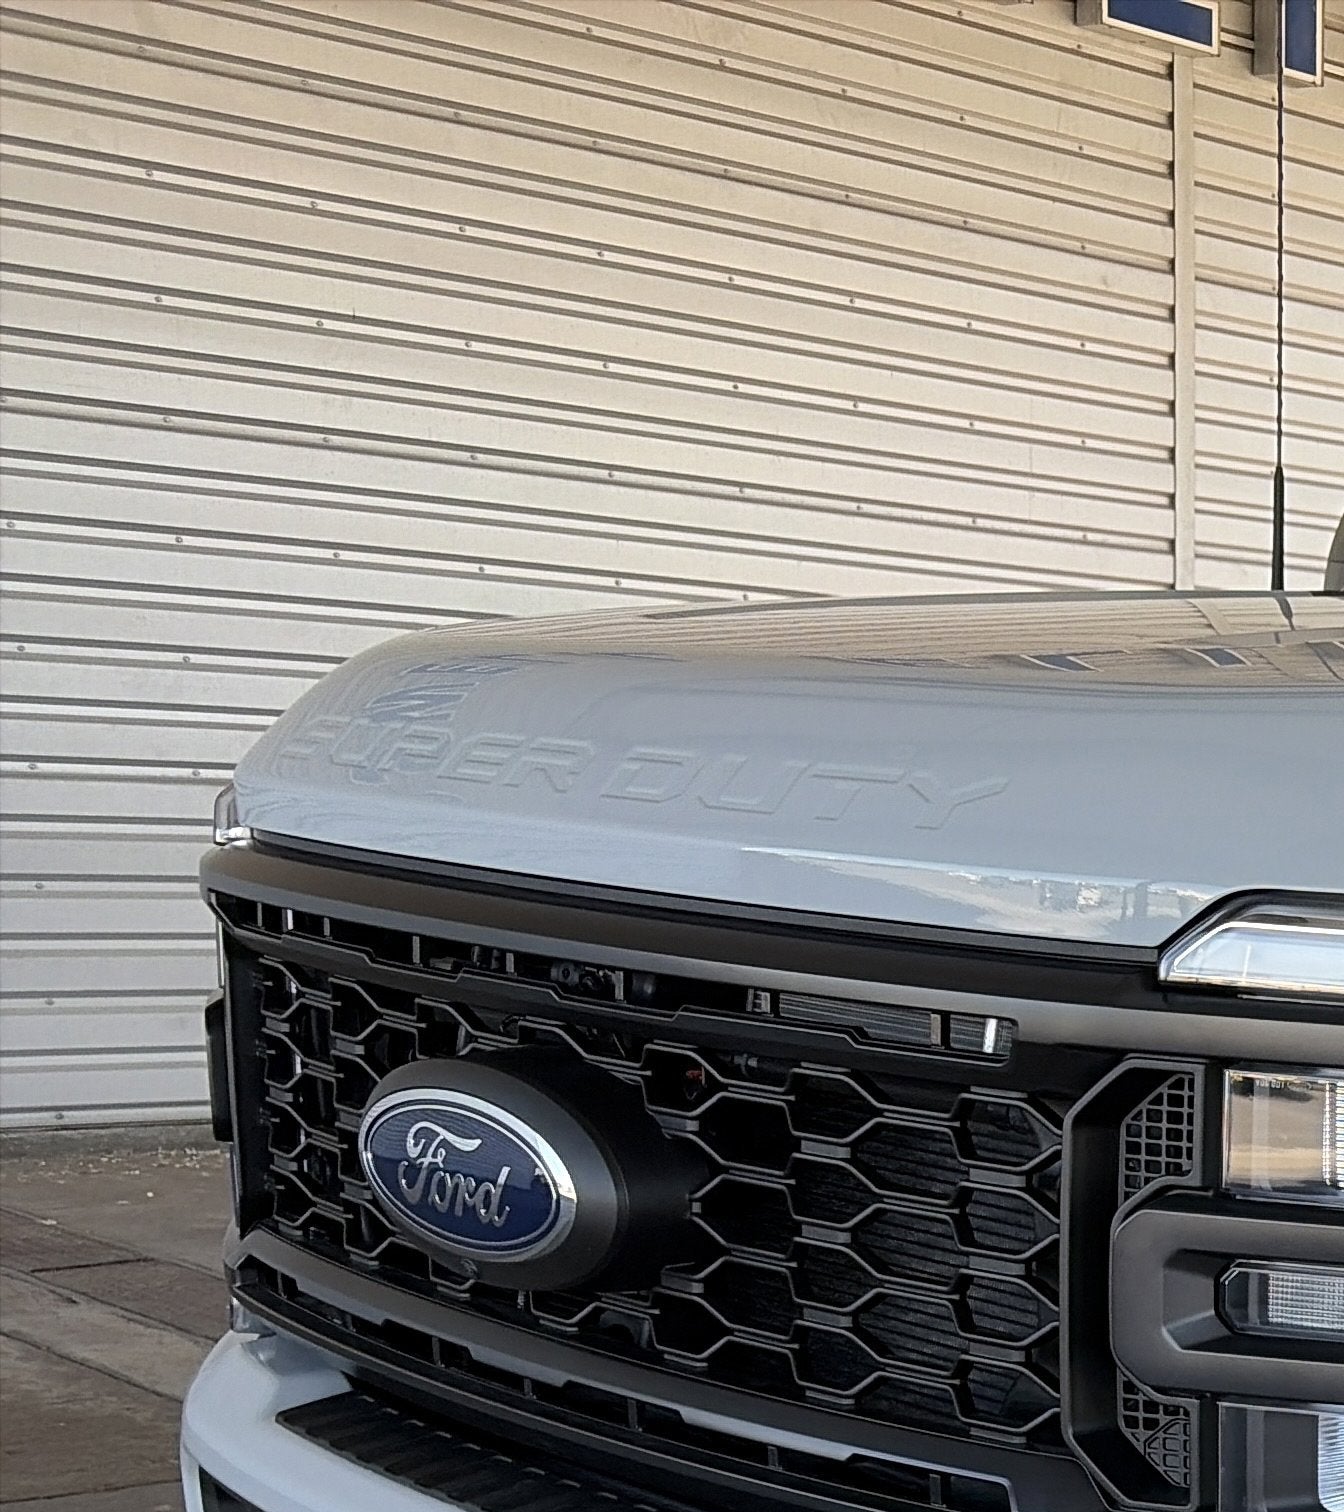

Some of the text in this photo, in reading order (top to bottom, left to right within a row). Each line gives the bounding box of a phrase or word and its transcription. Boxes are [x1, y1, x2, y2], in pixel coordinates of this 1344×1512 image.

[281, 716, 1013, 830] SUPER DUTY
[400, 1120, 511, 1228] Ford
